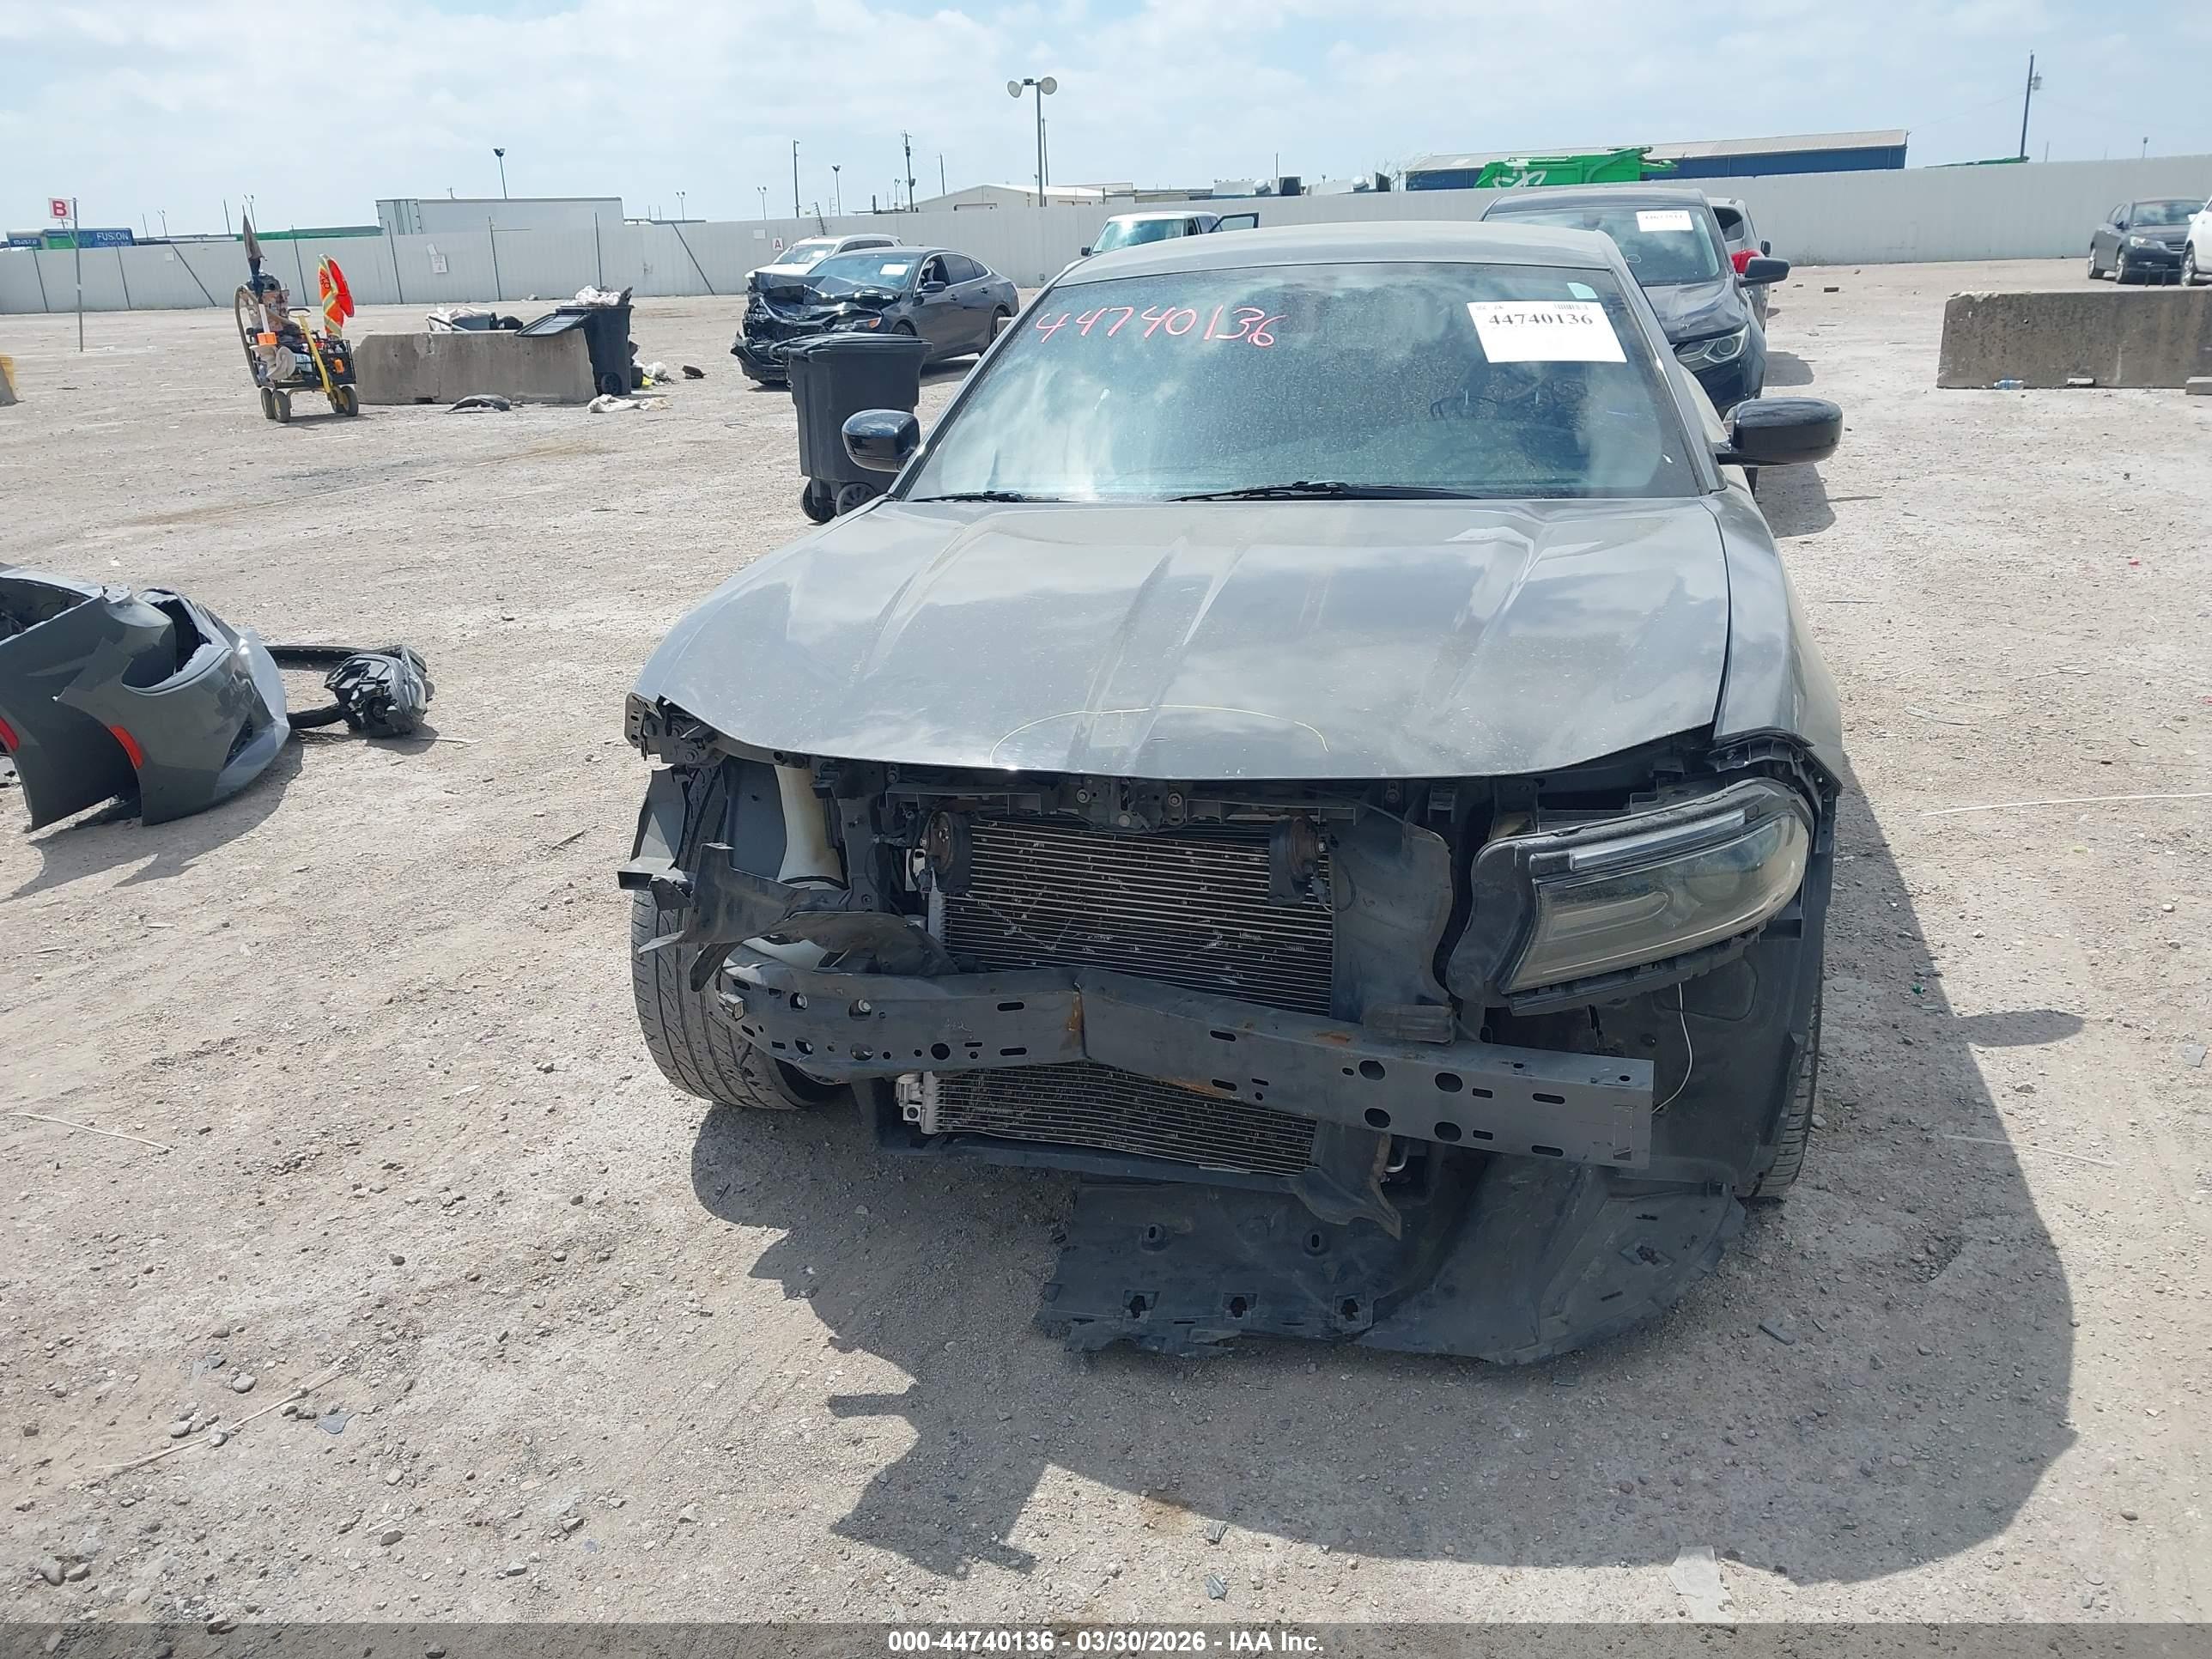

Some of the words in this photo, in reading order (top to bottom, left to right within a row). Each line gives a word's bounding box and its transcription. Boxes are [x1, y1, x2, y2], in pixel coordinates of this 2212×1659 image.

[52, 200, 67, 216] B
[775, 240, 781, 249] A
[1036, 305, 1287, 346] 44740136
[1488, 313, 1594, 325] 44740136
